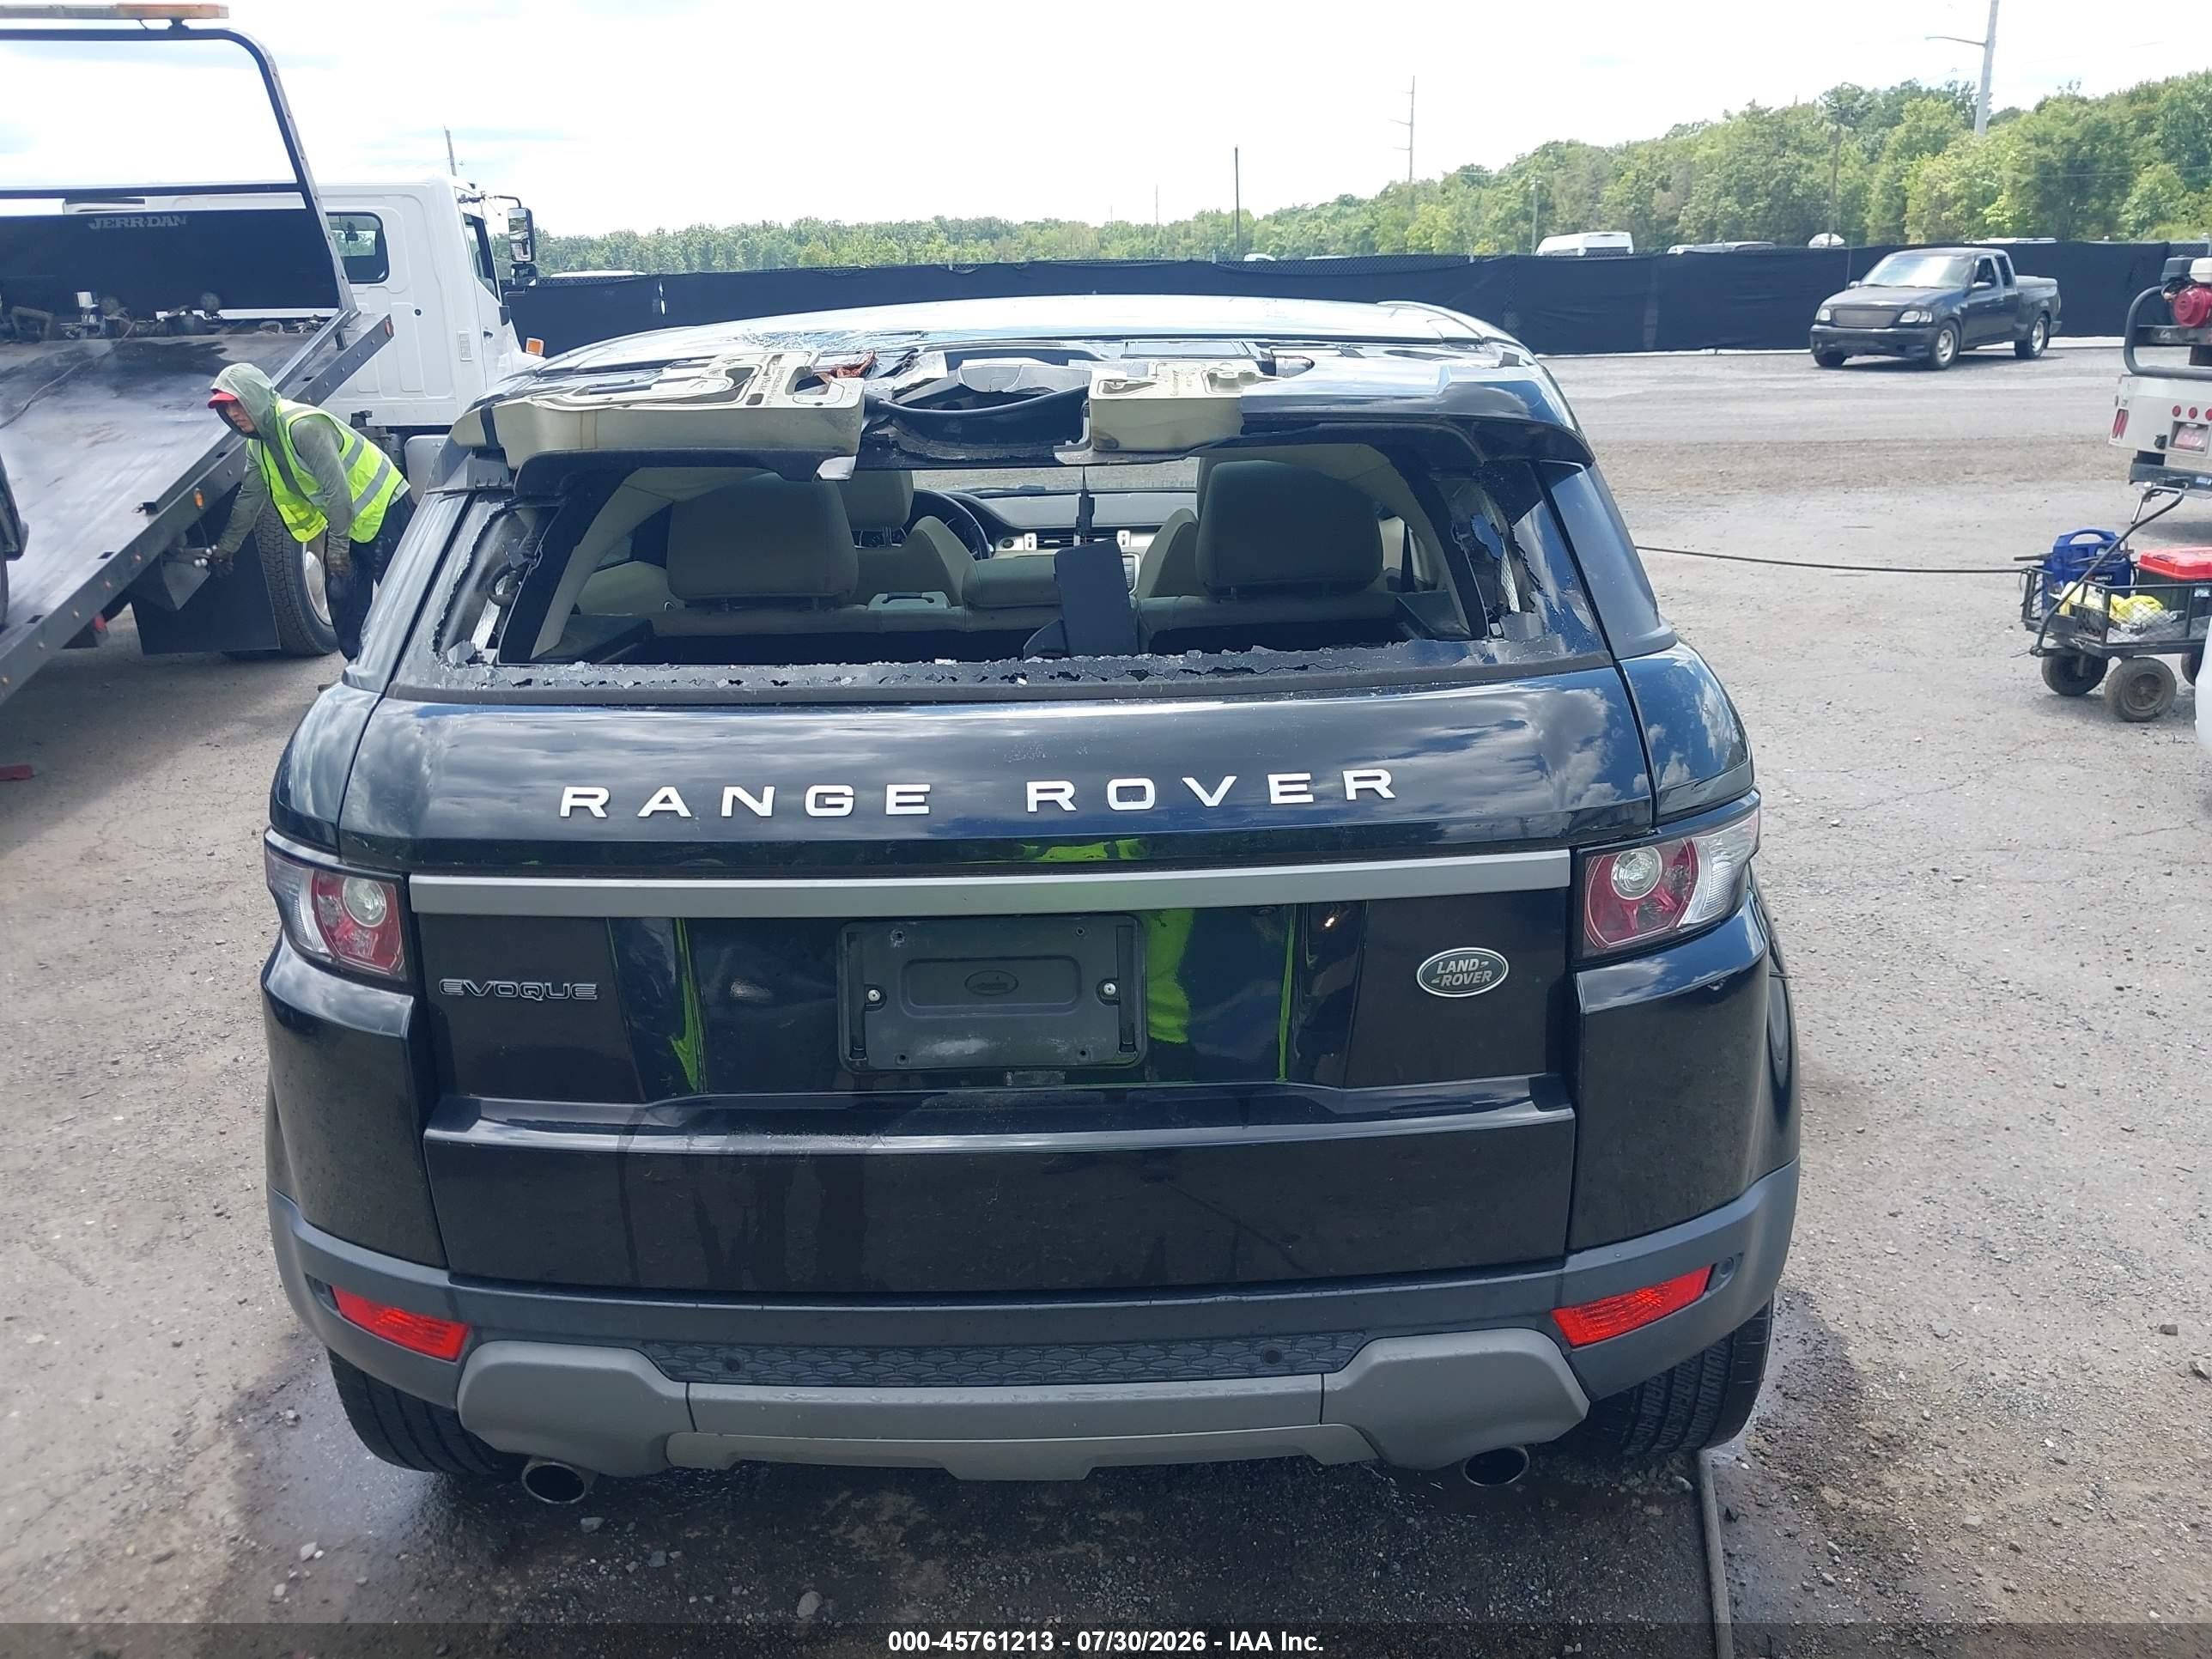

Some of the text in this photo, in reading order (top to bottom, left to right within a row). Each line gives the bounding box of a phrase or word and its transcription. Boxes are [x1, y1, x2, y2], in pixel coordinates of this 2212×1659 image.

[559, 769, 1397, 818] RANGE ROVER
[439, 978, 599, 1001] EVOQUE
